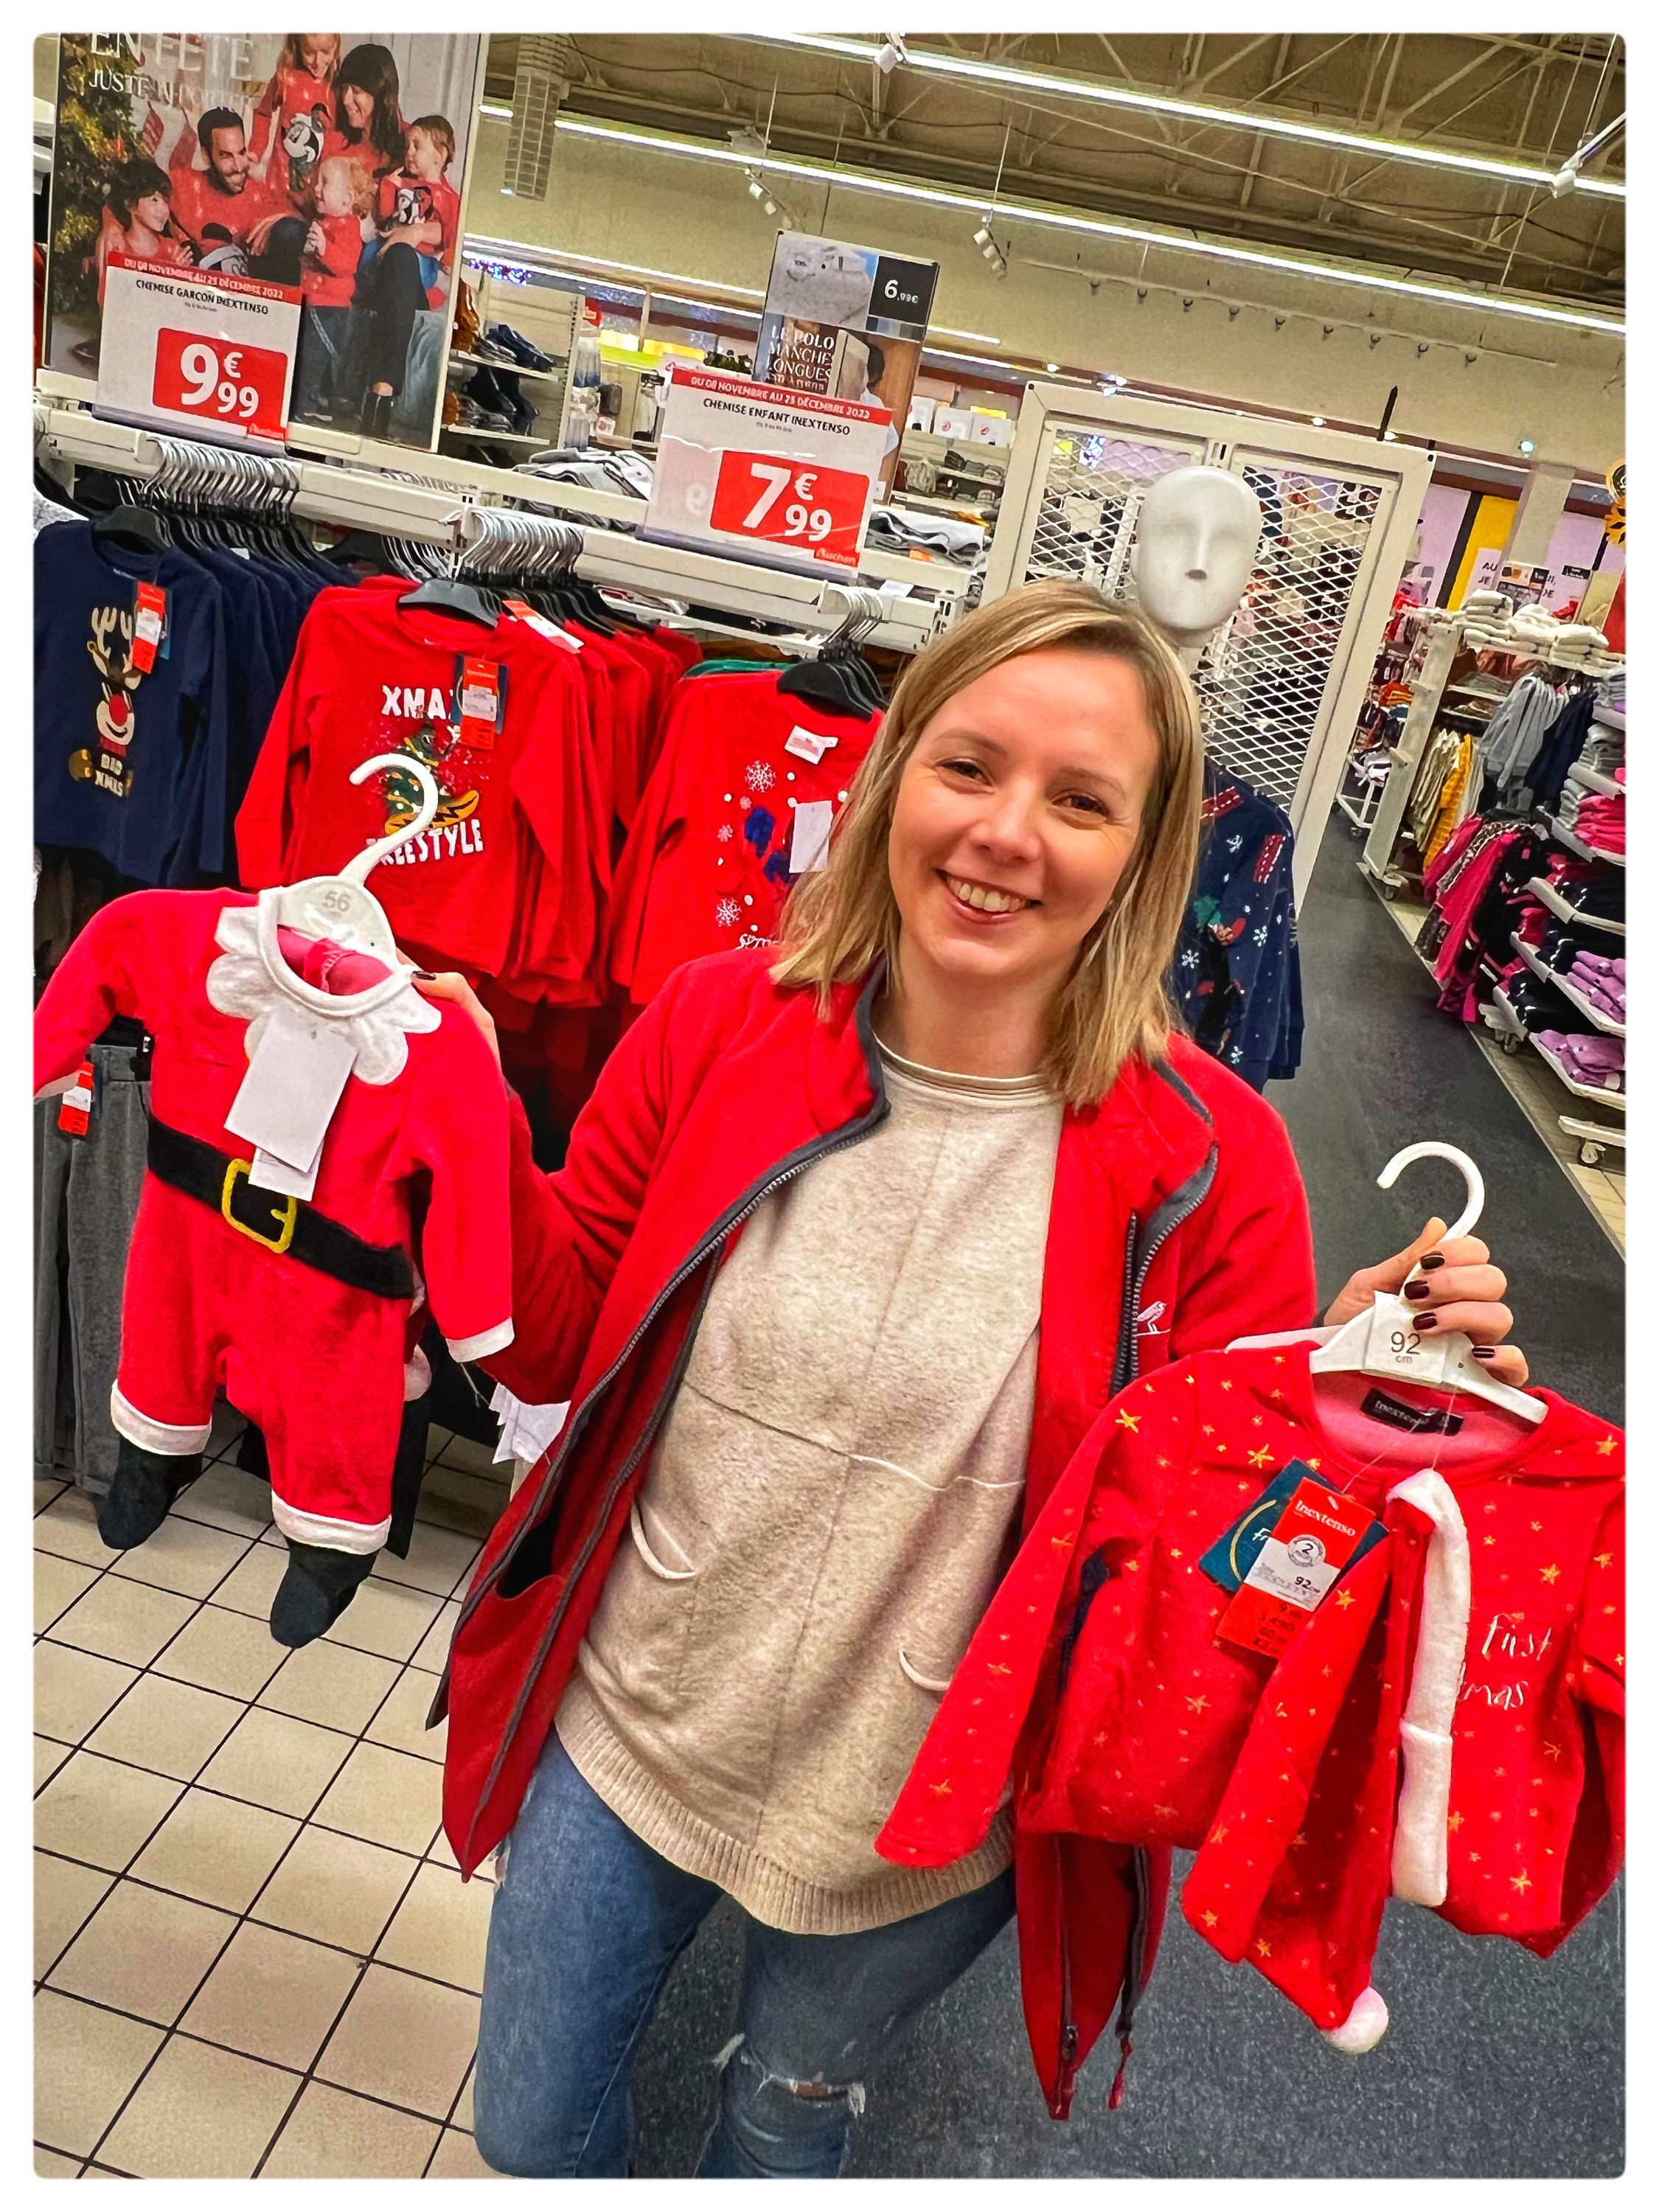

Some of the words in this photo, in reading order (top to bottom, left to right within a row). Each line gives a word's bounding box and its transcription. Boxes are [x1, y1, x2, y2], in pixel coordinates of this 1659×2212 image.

[136, 279, 175, 295] CHEMISE
[217, 296, 268, 315] INEXTENSO
[718, 382, 768, 399] NOVEMBRE
[769, 392, 783, 402] AU
[703, 398, 746, 415] CHEMISE
[749, 407, 790, 423] ENFANT
[791, 416, 850, 435] INEXTENSO
[381, 684, 454, 720] XMA
[323, 891, 350, 911] 56
[1391, 1331, 1422, 1355] 92
[1396, 1355, 1413, 1363] cm
